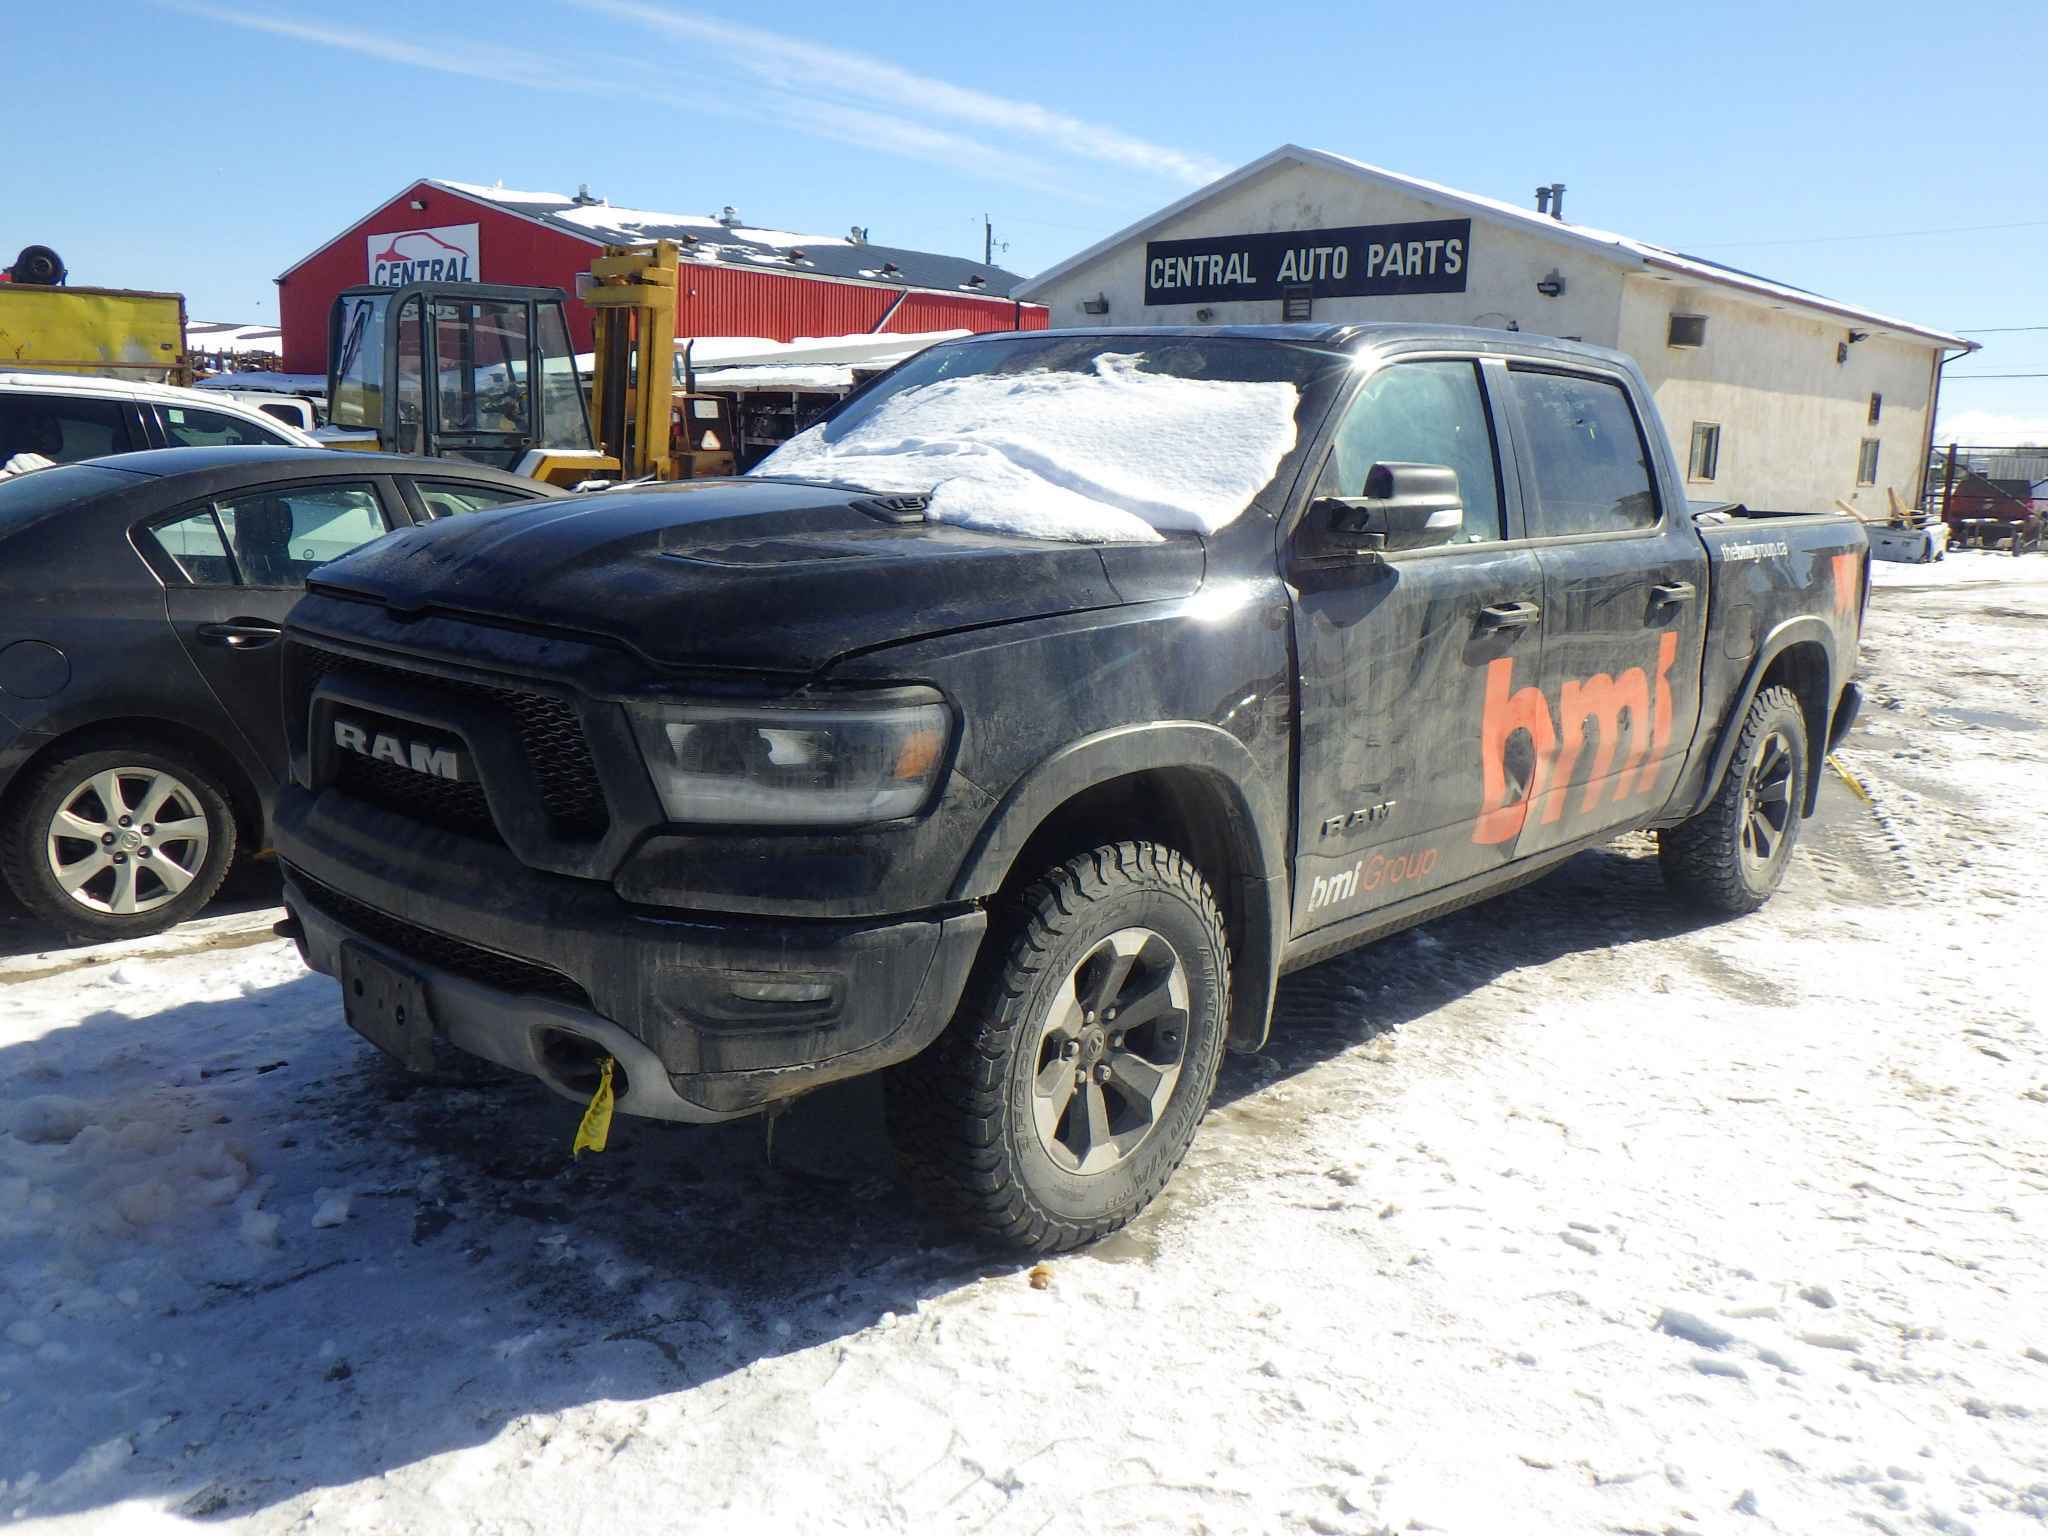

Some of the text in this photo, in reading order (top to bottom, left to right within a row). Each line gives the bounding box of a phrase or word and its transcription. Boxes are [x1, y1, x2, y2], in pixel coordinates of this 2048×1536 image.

[375, 256, 472, 288] CENTRAL
[1150, 238, 1463, 289] CENTRAL AUTO PARTS
[334, 720, 459, 781] RAM
[1319, 800, 1396, 840] RAM
